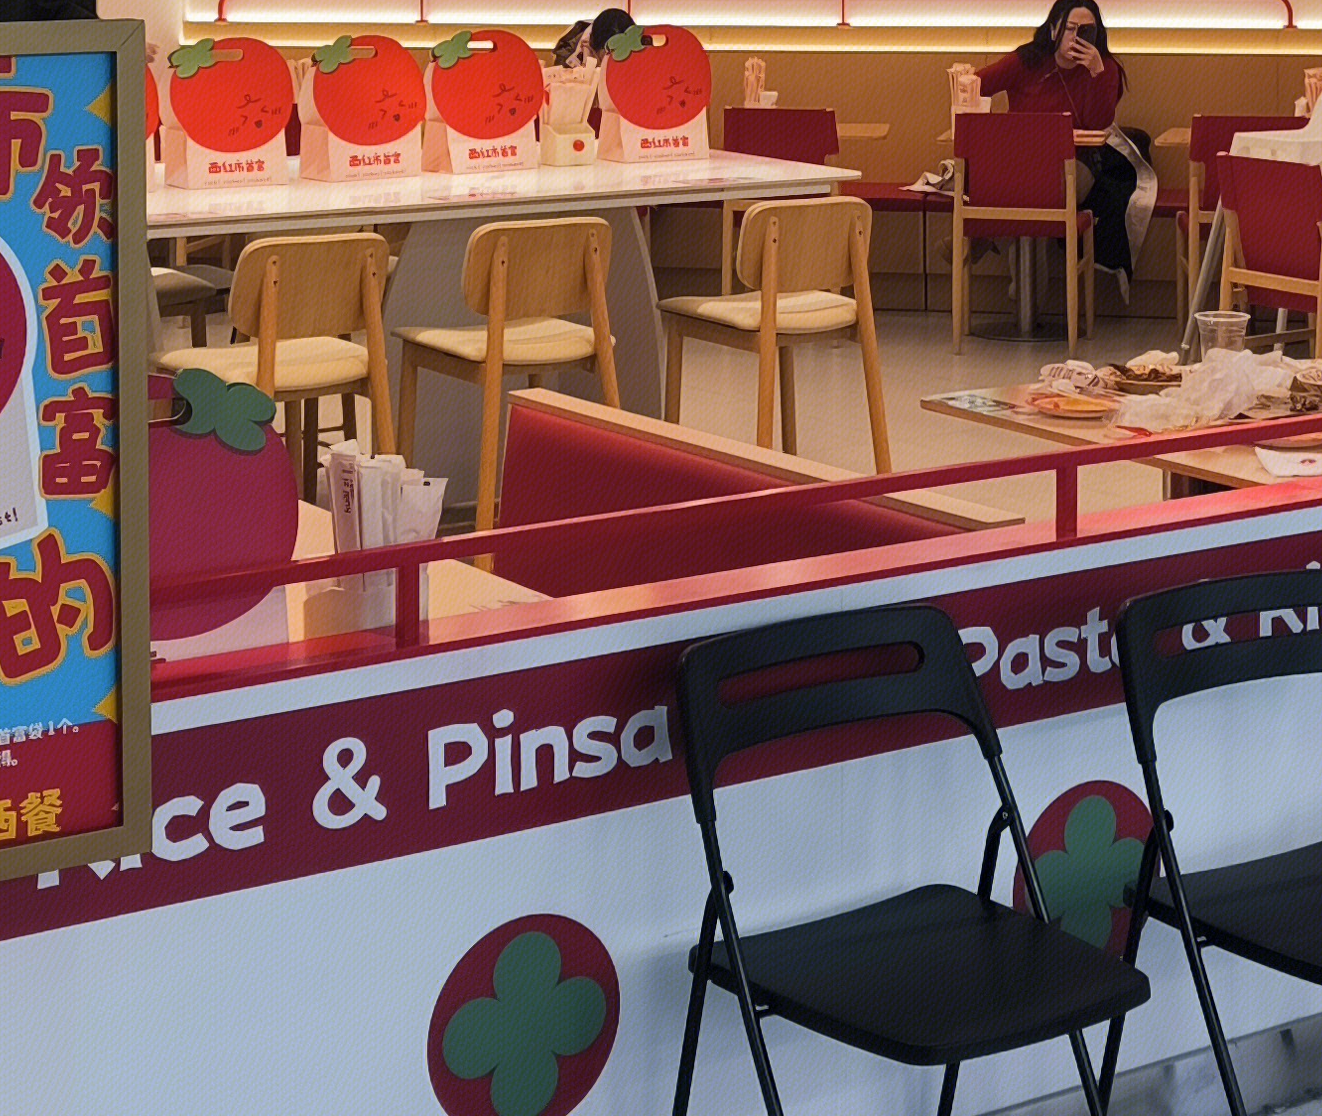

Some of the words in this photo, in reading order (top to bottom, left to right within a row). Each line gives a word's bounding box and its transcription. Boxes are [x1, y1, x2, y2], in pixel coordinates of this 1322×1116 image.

[961, 606, 1119, 691] Past
[311, 736, 388, 831] &
[427, 705, 675, 811] Pinsa
